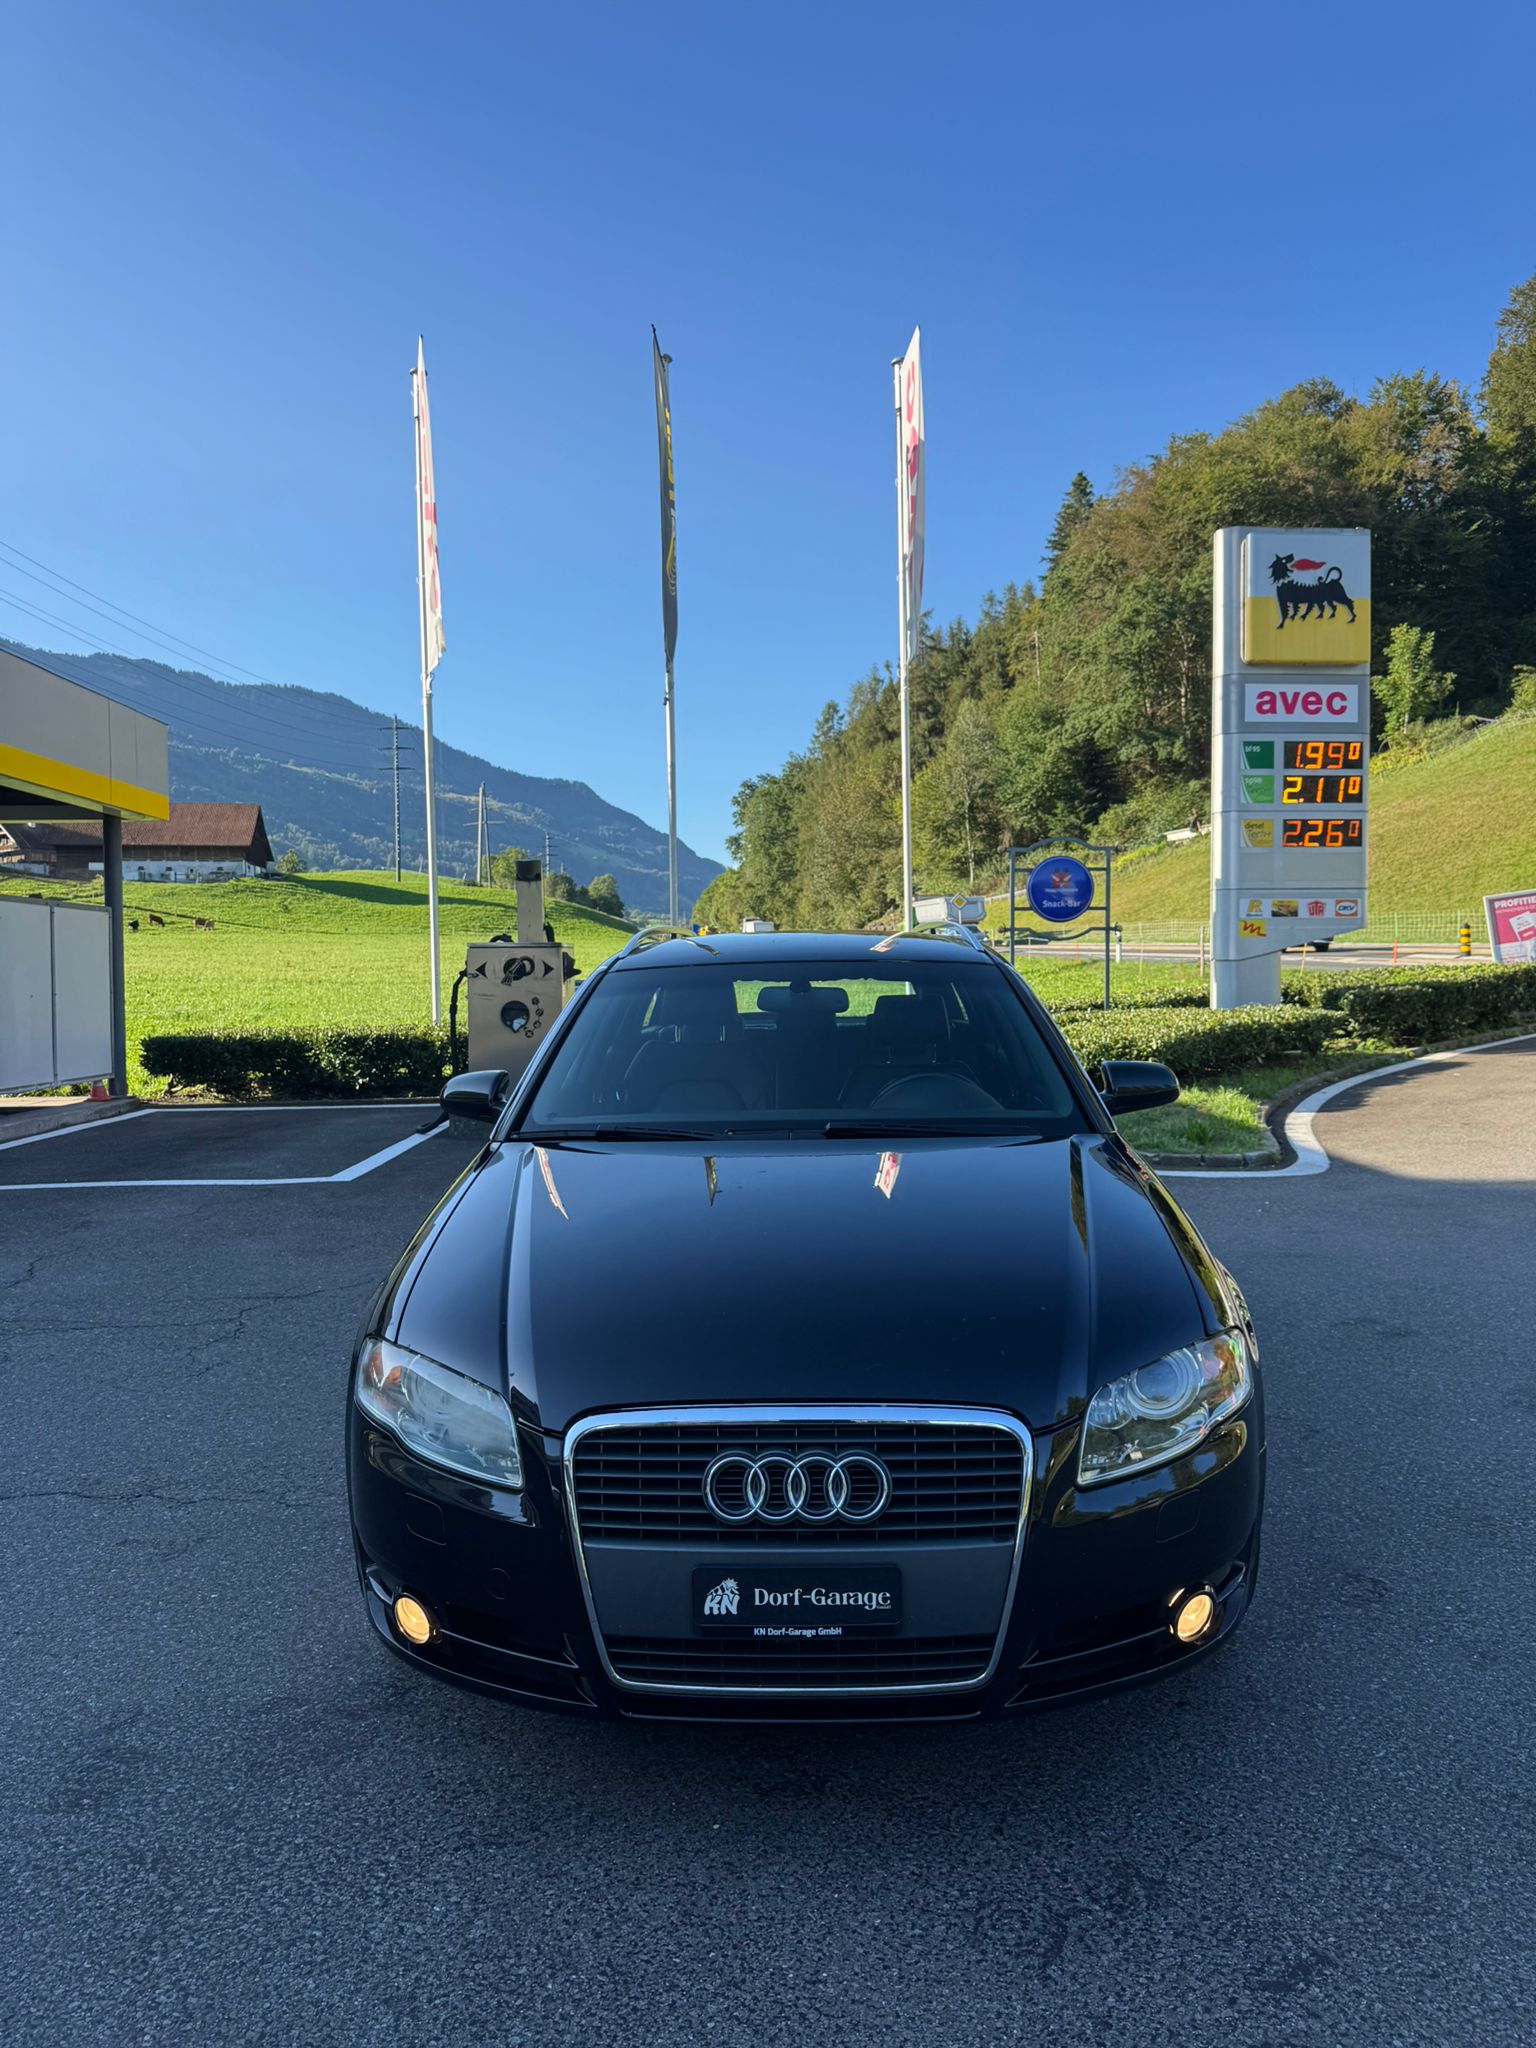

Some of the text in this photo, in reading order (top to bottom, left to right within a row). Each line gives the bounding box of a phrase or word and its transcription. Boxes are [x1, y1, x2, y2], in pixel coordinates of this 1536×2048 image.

[1255, 690, 1348, 716] avec
[704, 1588, 891, 1616] KN Dorf-Garage
[753, 1627, 842, 1638] KN Dorf-Garage GmbH
